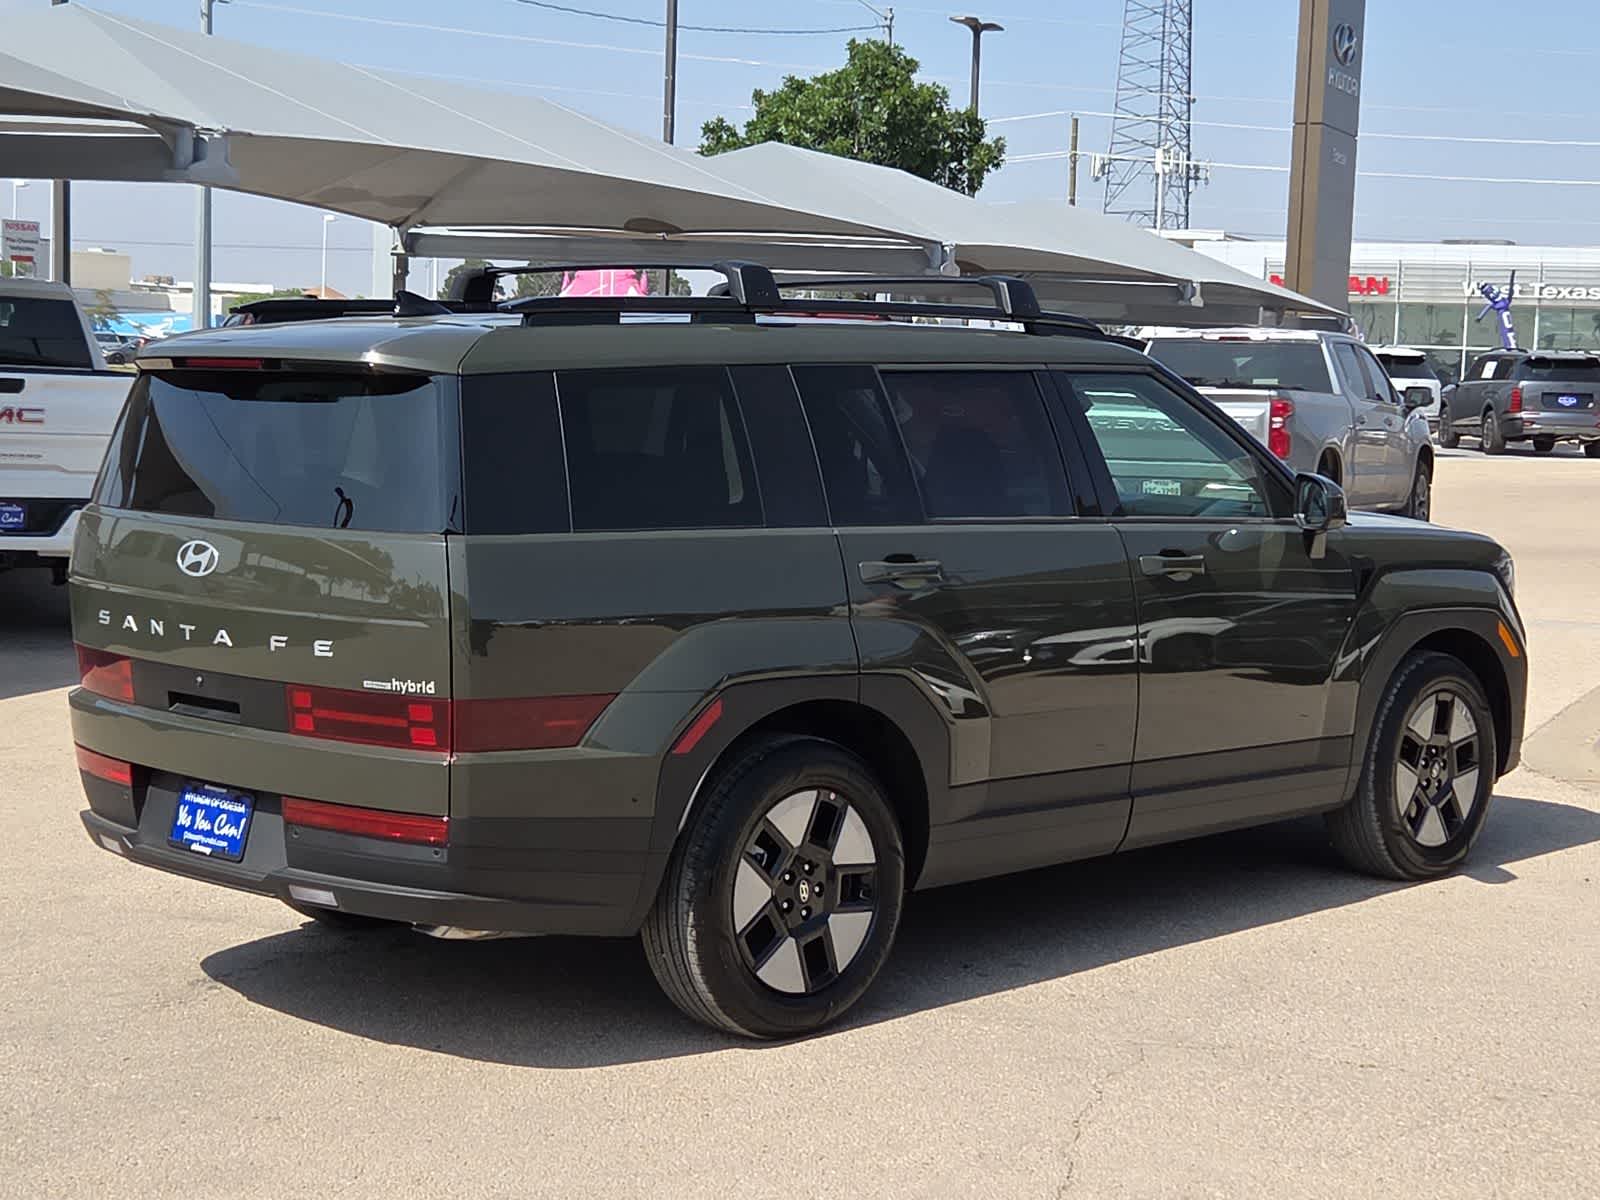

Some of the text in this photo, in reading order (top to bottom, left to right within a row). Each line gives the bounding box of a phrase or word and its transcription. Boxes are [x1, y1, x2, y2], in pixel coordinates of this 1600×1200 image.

[5, 222, 39, 232] NISSAN
[1529, 282, 1600, 300] Texas
[98, 609, 334, 657] SANTA FE
[391, 678, 436, 695] hybrid
[176, 804, 193, 828] Yes
[193, 808, 212, 832] You
[213, 813, 247, 840] Can!
